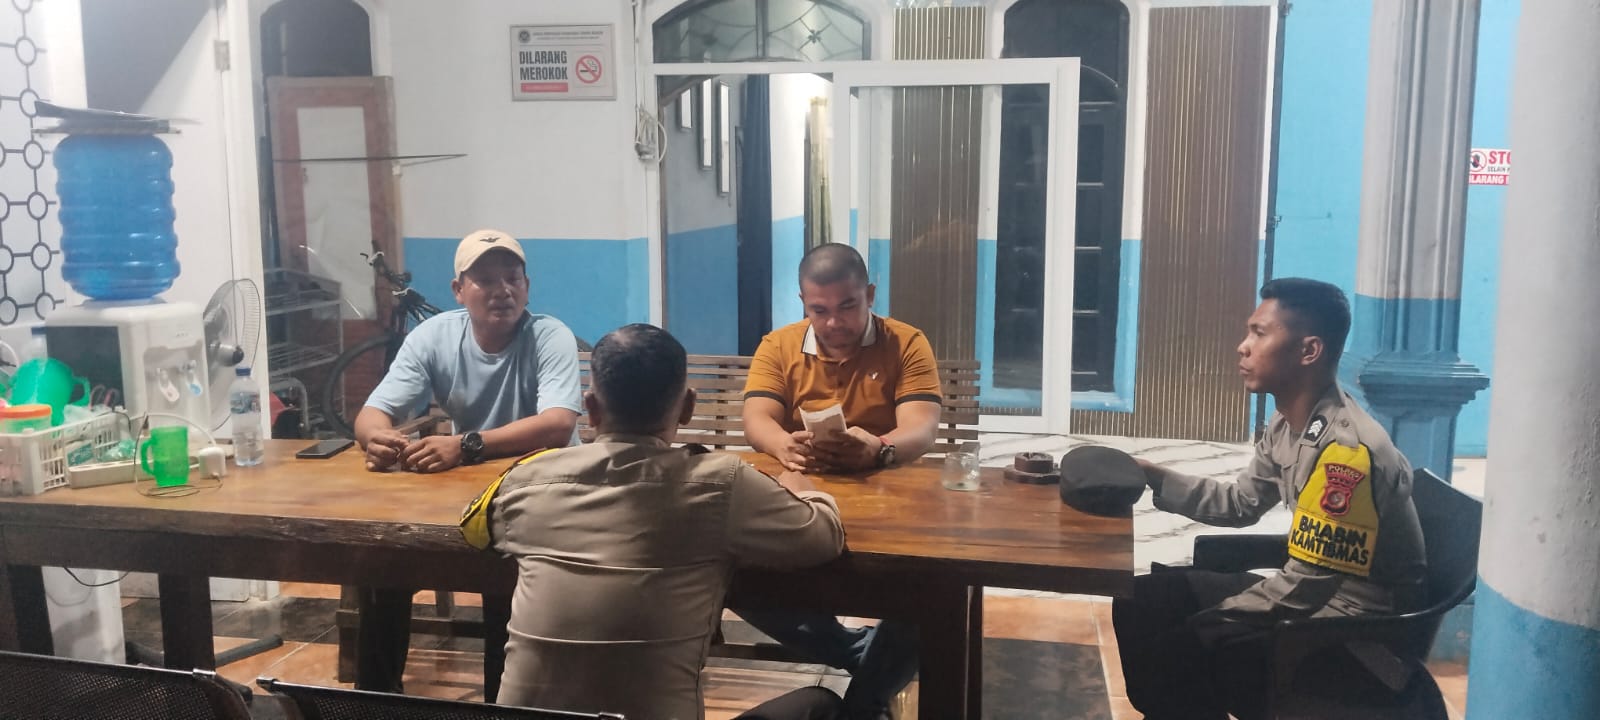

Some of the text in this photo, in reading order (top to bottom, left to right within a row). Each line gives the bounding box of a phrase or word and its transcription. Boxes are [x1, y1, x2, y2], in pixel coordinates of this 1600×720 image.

[519, 50, 567, 64] DILARANG
[520, 66, 569, 80] MEROKOK
[1299, 515, 1367, 548] BHABIN
[1291, 528, 1369, 565] KAMTIBMAS
